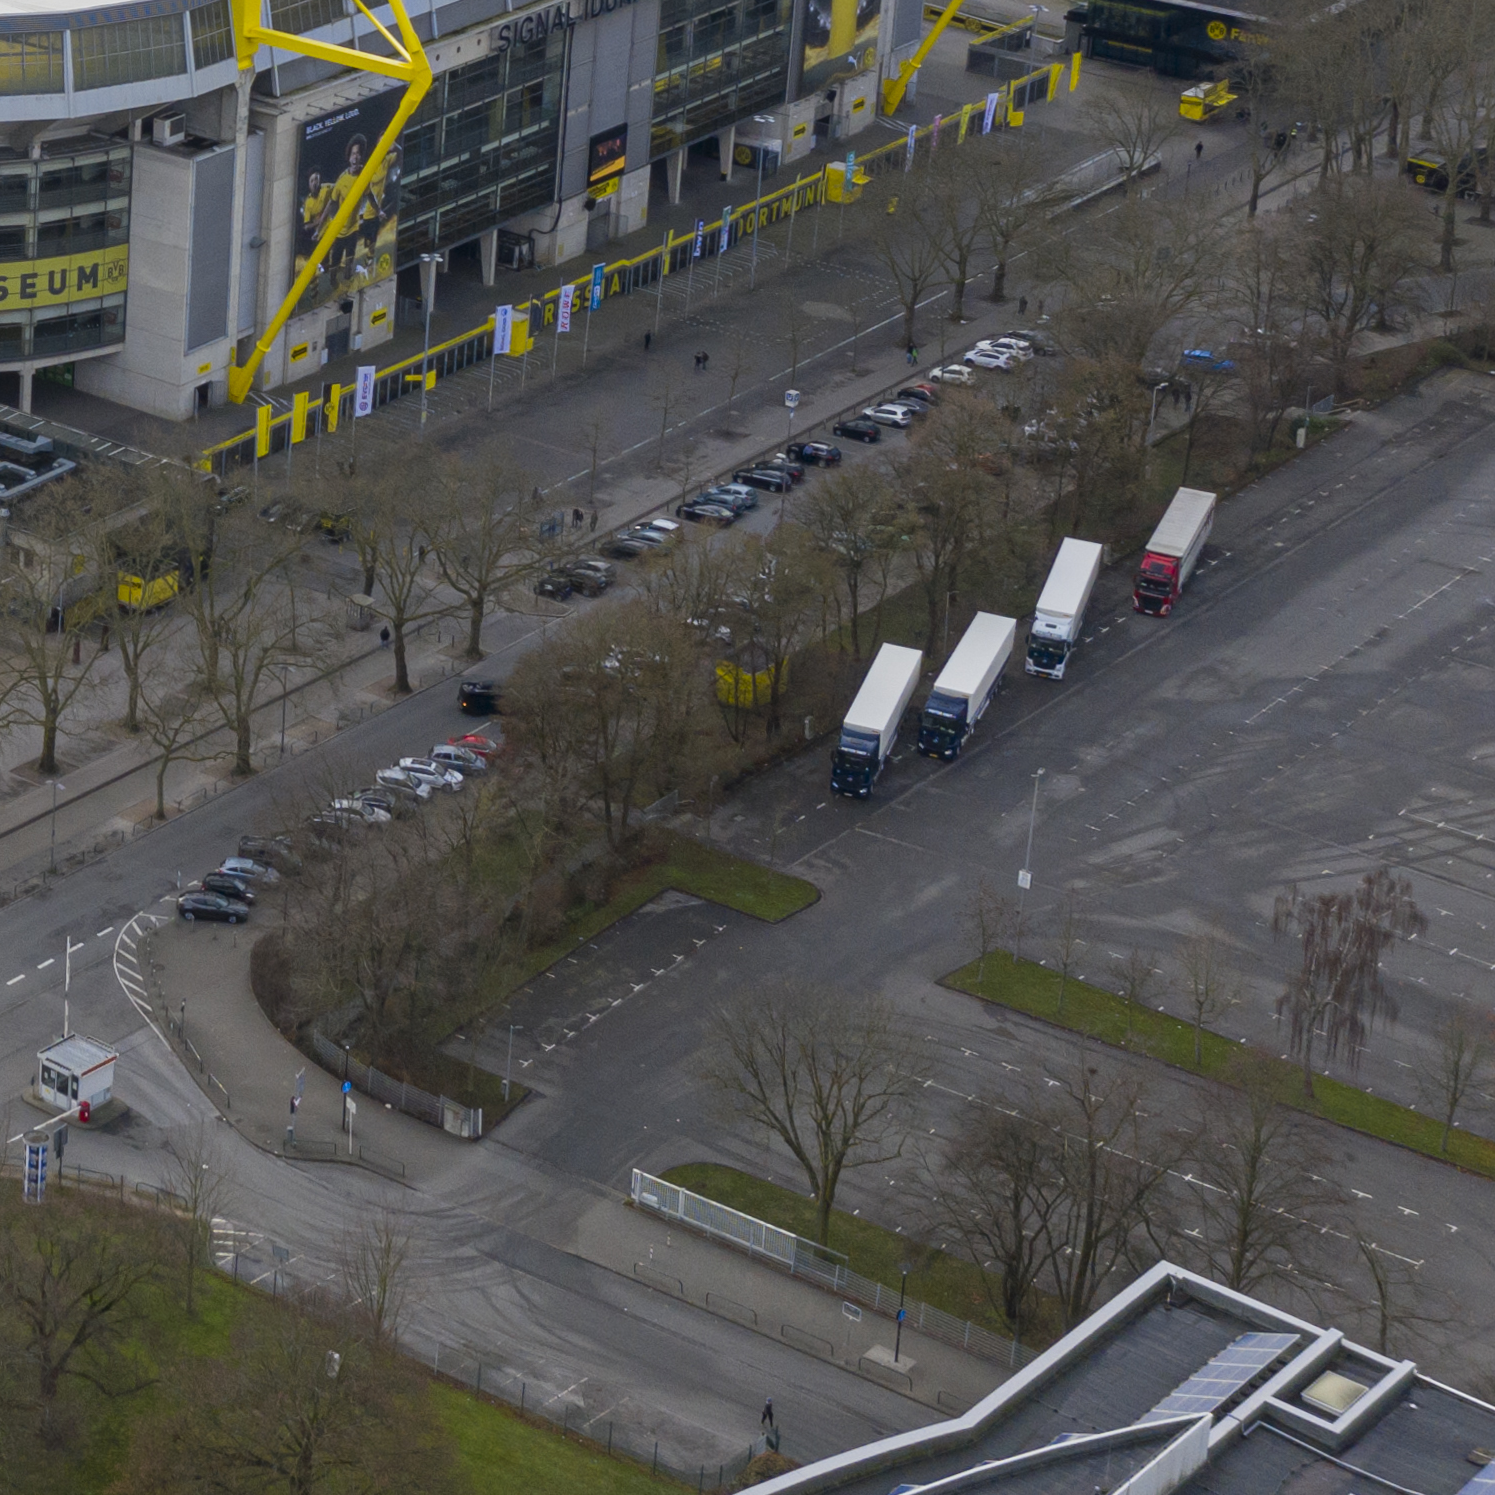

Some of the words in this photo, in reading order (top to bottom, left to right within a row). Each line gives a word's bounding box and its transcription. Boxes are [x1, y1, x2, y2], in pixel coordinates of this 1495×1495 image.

[498, 1, 576, 54] SIGNAL
[107, 259, 125, 279] BVB
[562, 290, 571, 330] ROWE
